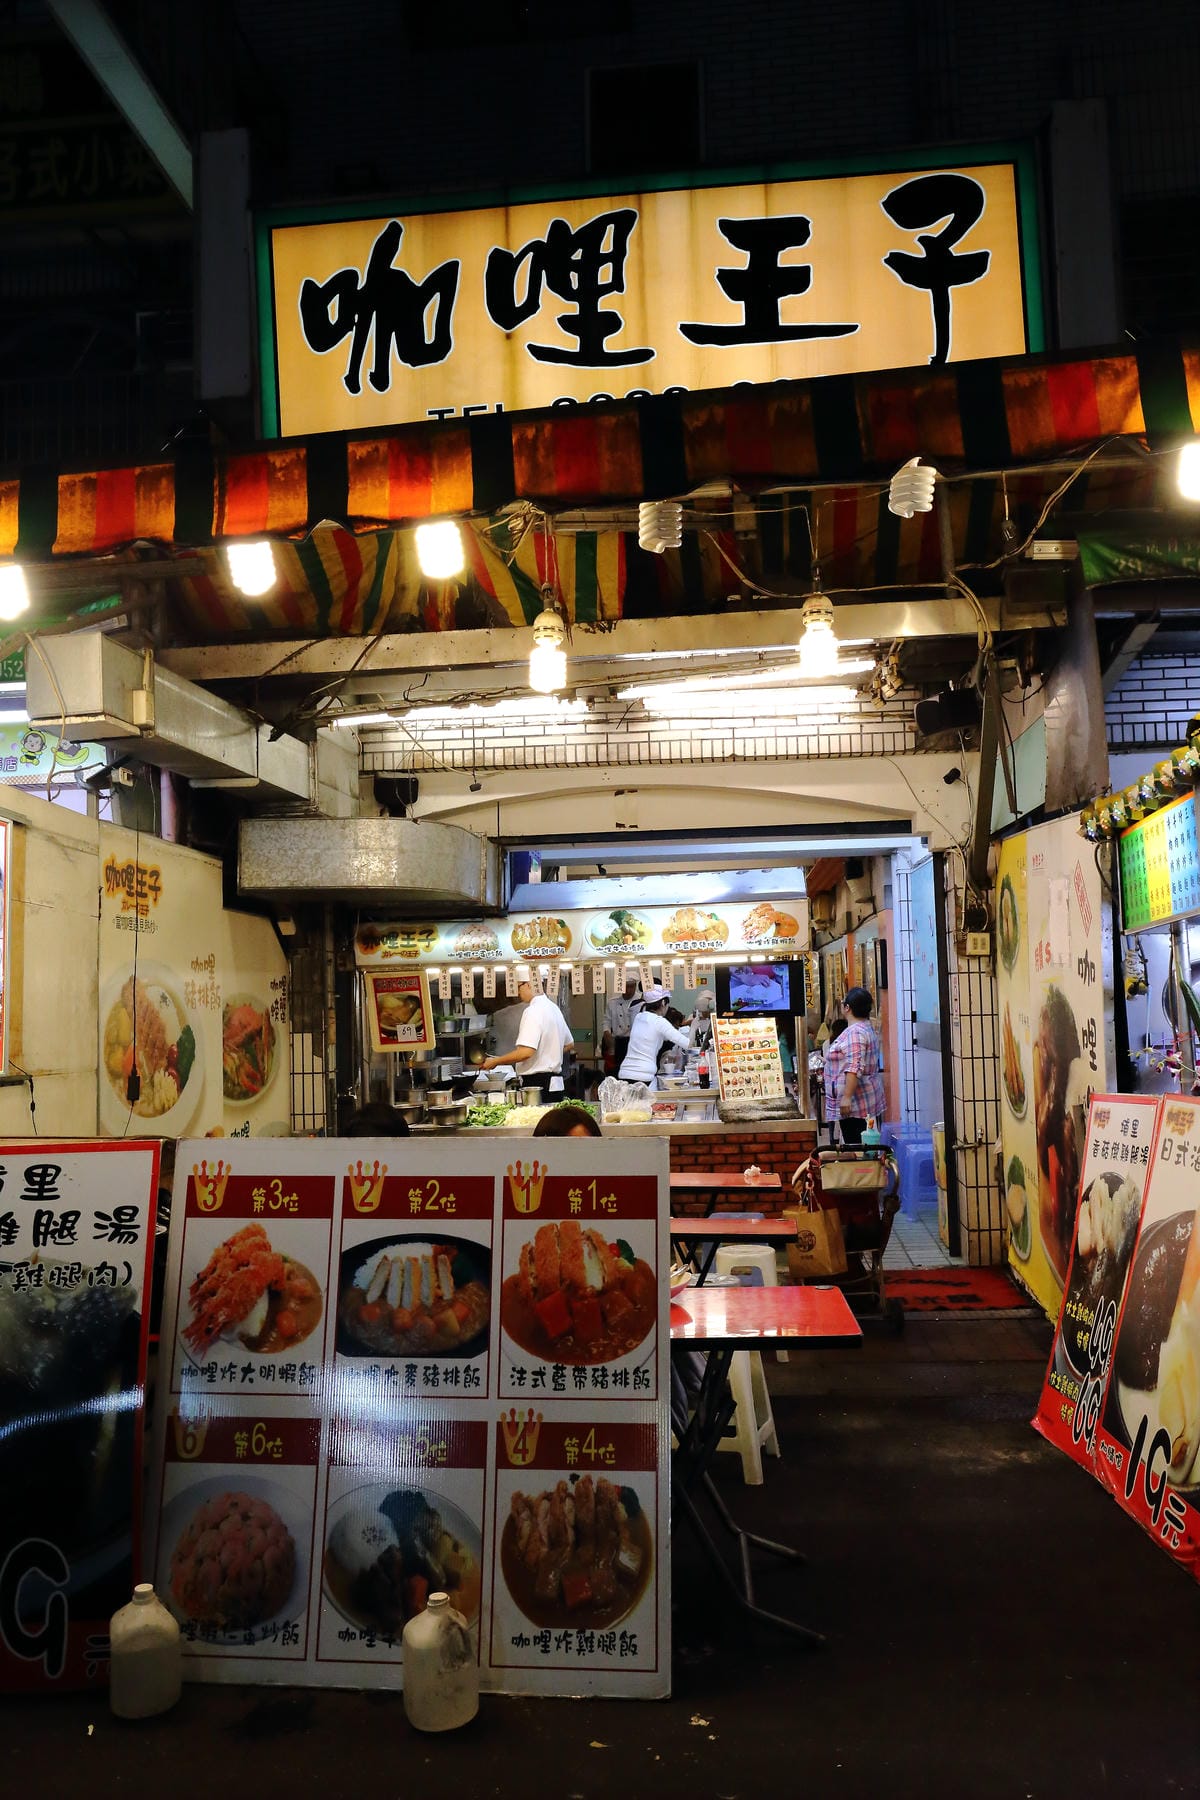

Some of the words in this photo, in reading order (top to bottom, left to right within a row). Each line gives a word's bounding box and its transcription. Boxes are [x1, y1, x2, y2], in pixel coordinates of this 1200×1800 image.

[299, 172, 991, 395] 咖哩王子
[0, 659, 24, 679] 52
[105, 857, 161, 902] 咖哩王子
[0, 1164, 62, 1201] 里
[203, 1178, 217, 1210] 3
[252, 1178, 300, 1213] 第3位
[359, 1177, 374, 1208] 2
[408, 1179, 457, 1214] 第2位
[520, 1179, 531, 1211] 1
[567, 1179, 618, 1214] 第1位
[0, 1261, 133, 1291] 雞腿肉)
[181, 1361, 316, 1386] 咖哩炸大明蝦飯
[509, 1363, 651, 1391] 法式藍帶豬排飯
[233, 1422, 284, 1459] 第6位
[512, 1425, 529, 1462] 4
[564, 1427, 616, 1464] 第4位
[180, 1619, 299, 1646] 哩蝦仁蛋炒飯
[511, 1629, 638, 1657] 咖哩炸雞腿飯
